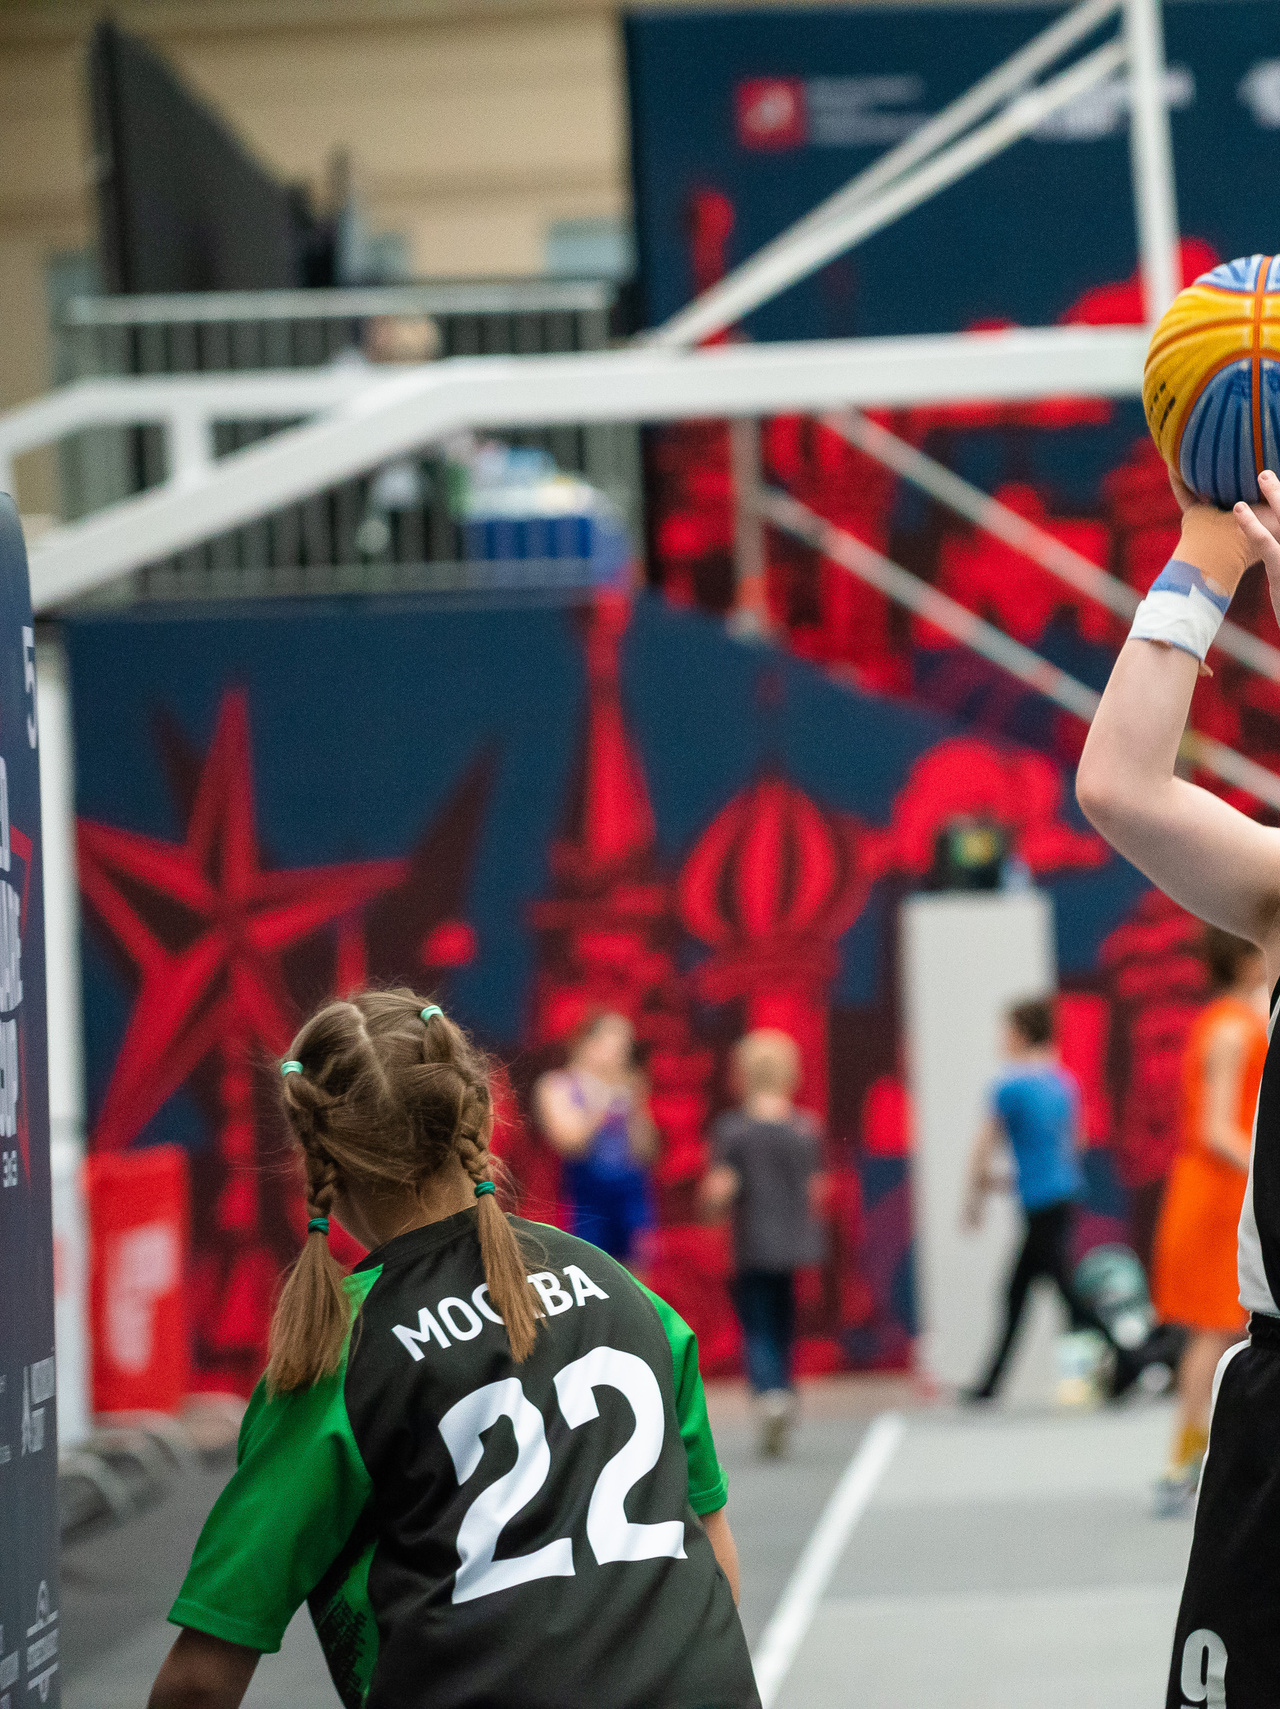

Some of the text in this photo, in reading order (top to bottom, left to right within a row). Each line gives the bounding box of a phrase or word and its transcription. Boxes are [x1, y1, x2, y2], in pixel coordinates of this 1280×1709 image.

[391, 1264, 611, 1362] МОСВА
[438, 1346, 688, 1605] 22
[1180, 1628, 1229, 1709] 9
